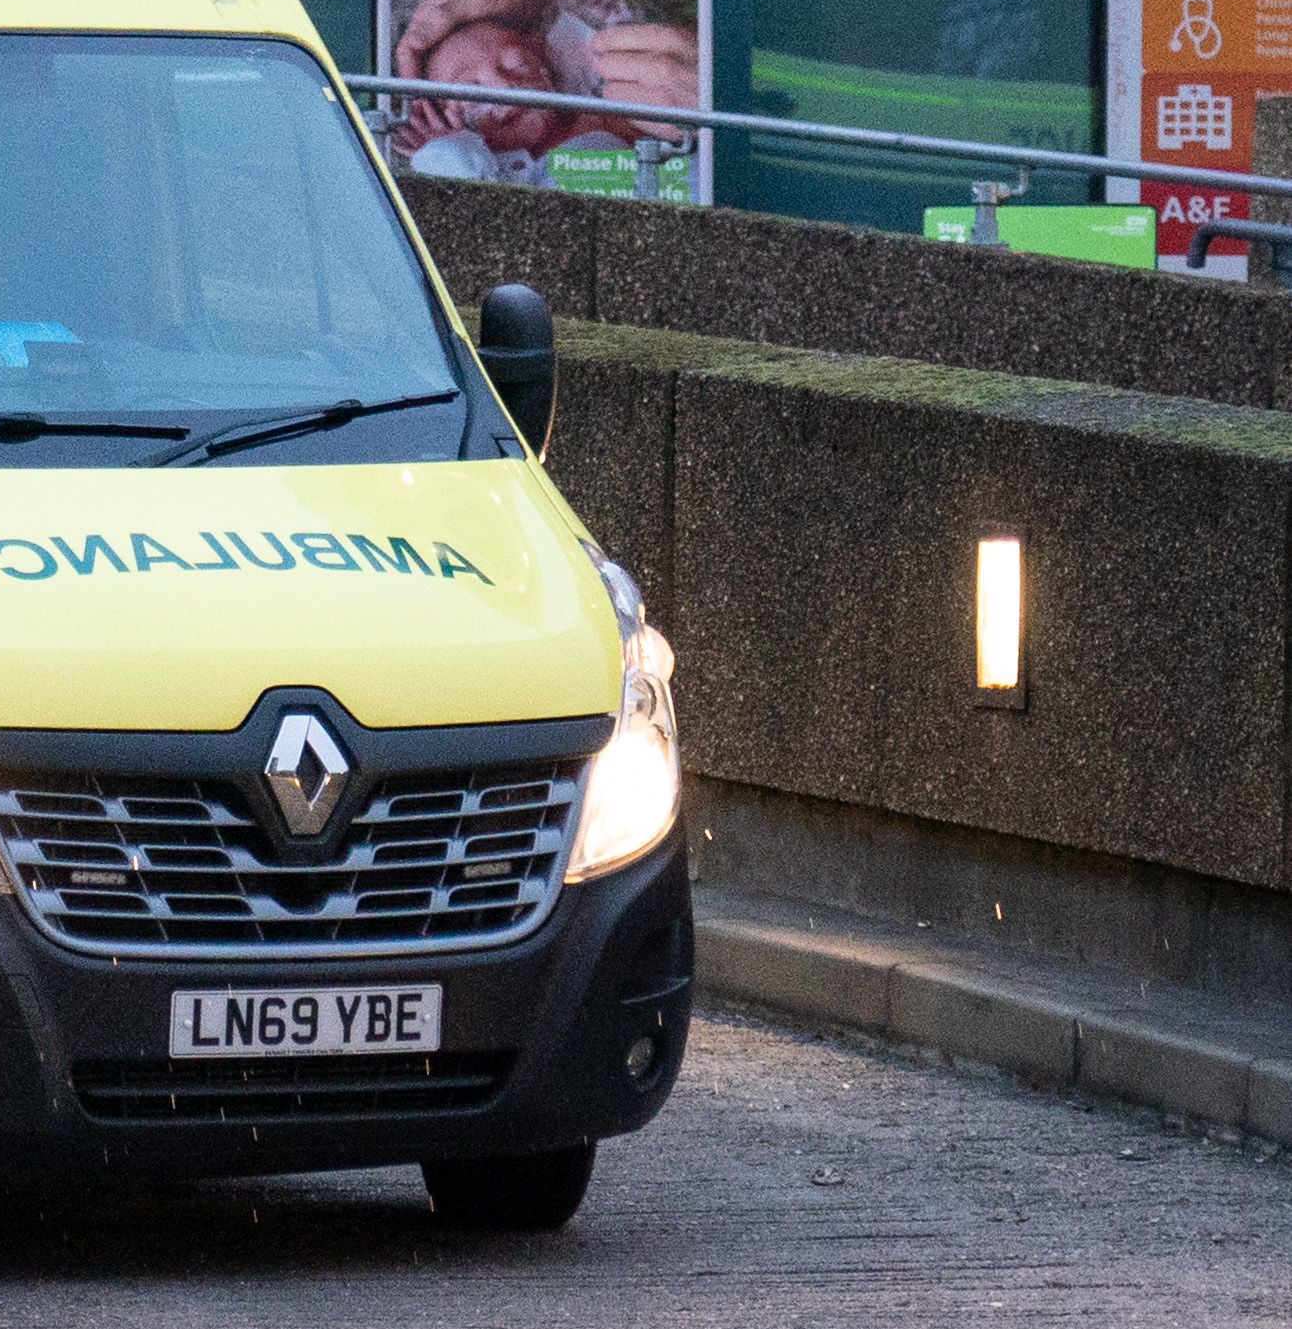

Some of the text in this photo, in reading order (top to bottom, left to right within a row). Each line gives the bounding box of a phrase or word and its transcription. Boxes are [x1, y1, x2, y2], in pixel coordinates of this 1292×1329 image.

[553, 154, 612, 171] Please
[617, 154, 636, 171] he
[192, 992, 423, 1047] LN69 YBE
